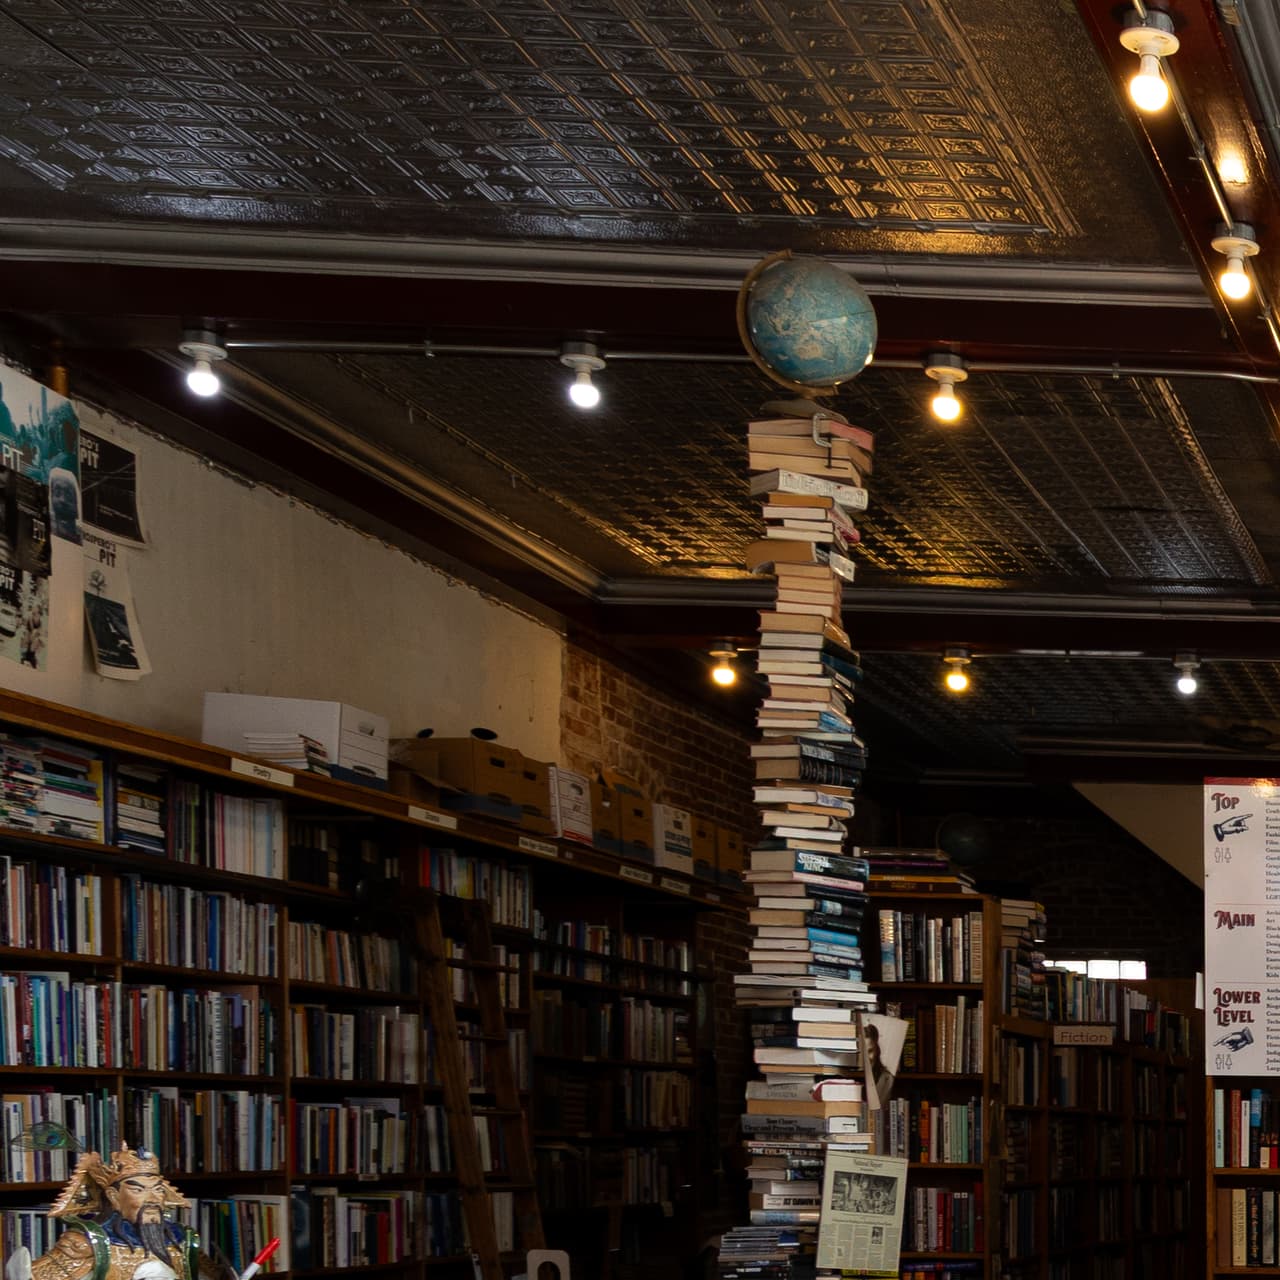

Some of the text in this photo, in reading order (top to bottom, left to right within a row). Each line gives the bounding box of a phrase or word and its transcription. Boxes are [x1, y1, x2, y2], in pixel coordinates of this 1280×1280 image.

[2, 445, 23, 471] PIT
[80, 450, 99, 468] PIT
[100, 550, 116, 567] PIT
[1211, 793, 1240, 813] TOP
[803, 862, 824, 873] KING
[1214, 911, 1255, 930] MAIN
[1213, 988, 1261, 1007] LOWER
[1213, 1007, 1254, 1026] LEVEL
